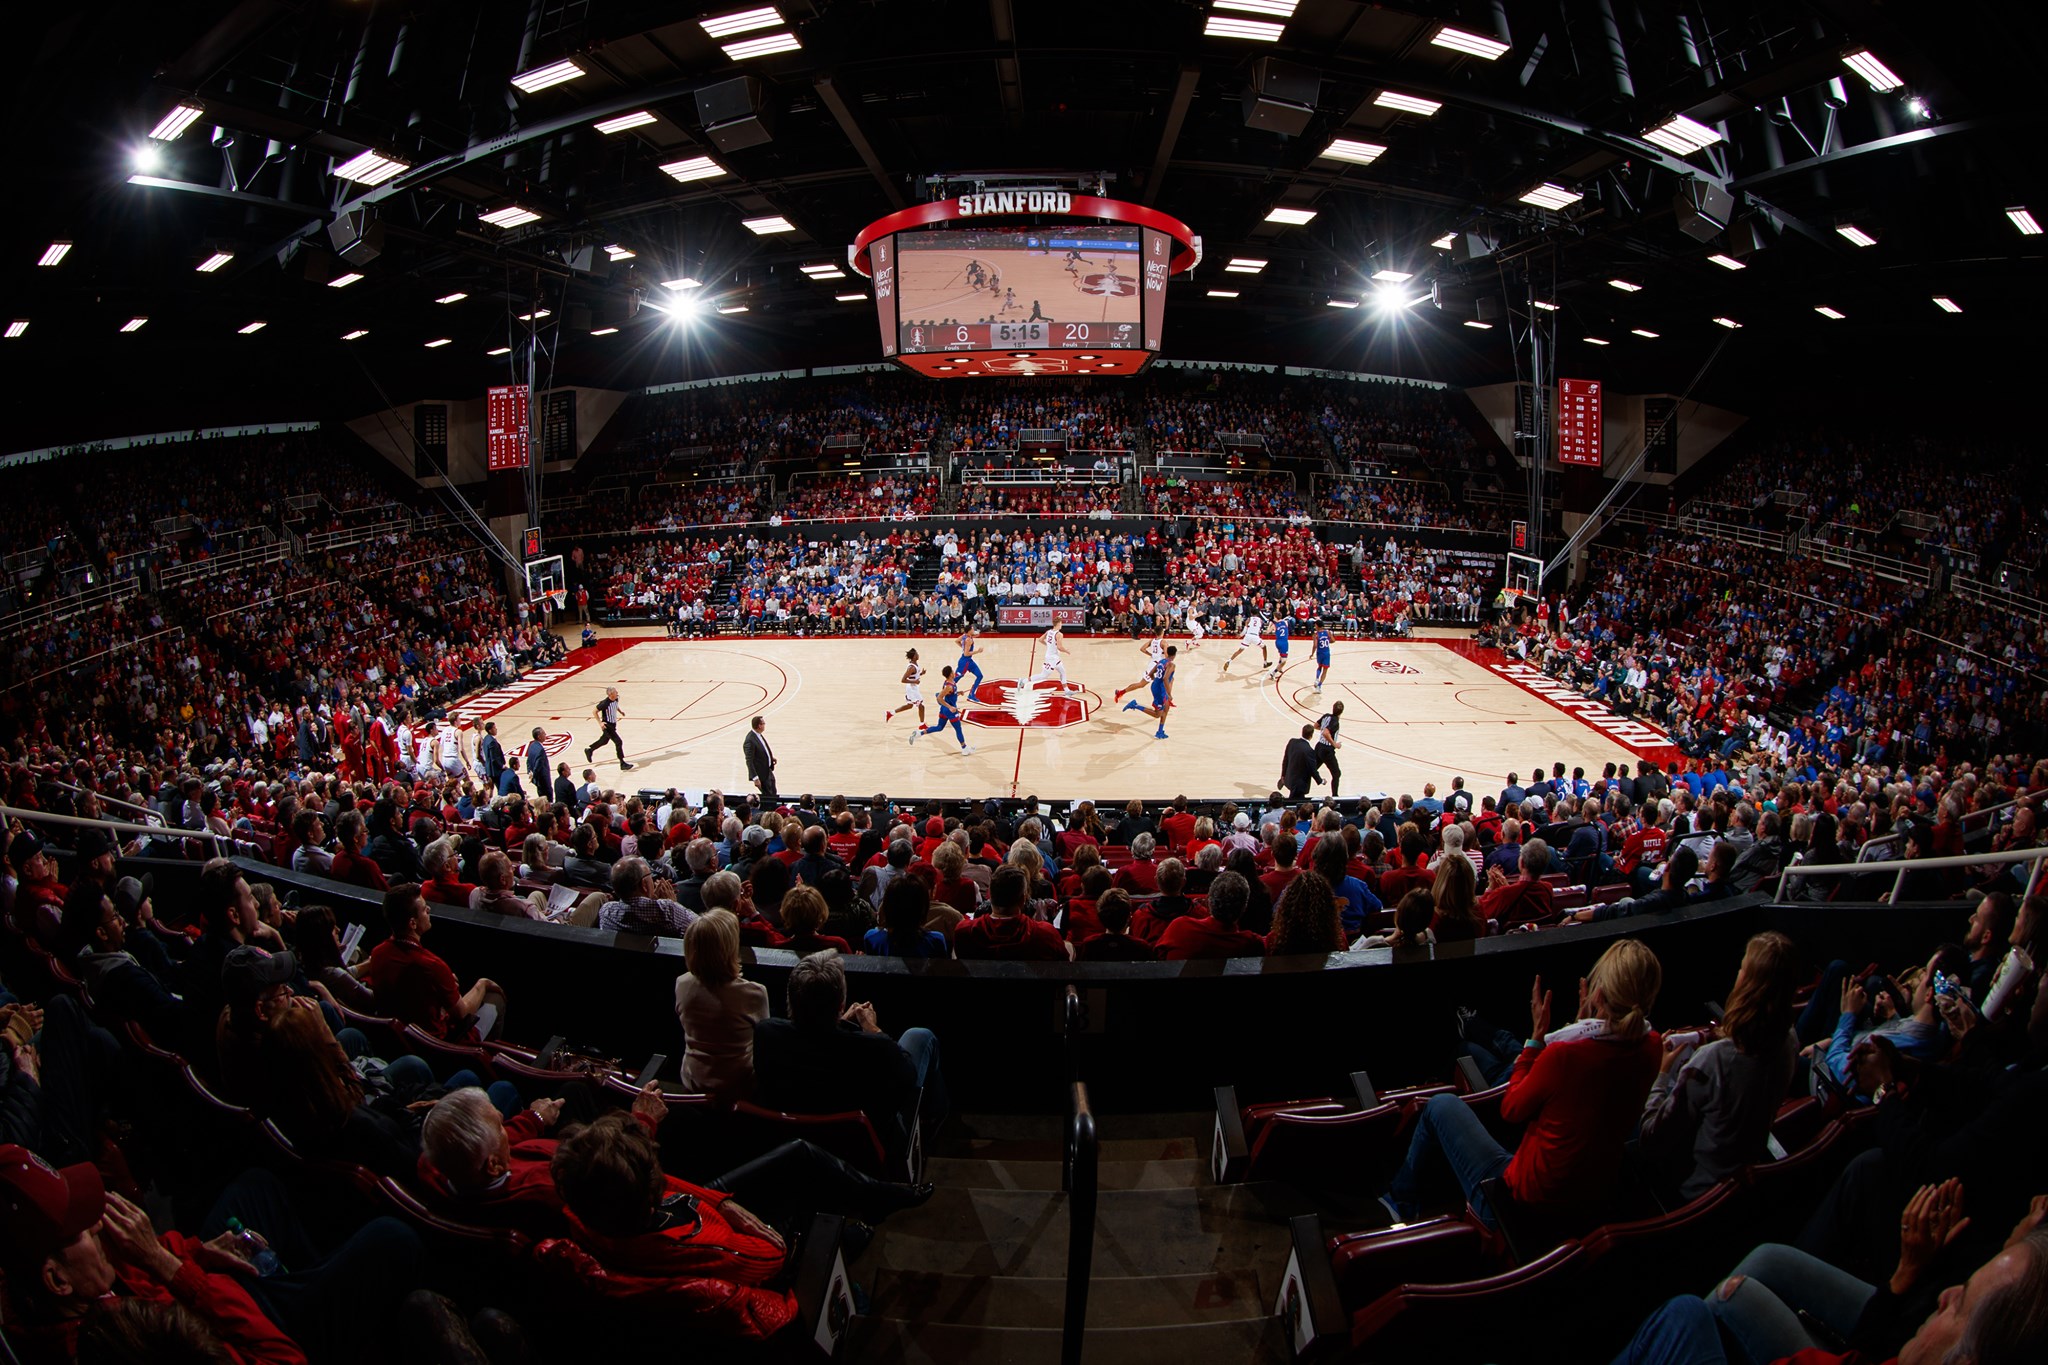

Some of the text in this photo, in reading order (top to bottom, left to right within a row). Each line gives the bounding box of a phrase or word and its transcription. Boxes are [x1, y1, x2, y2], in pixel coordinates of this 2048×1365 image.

[959, 192, 1071, 216] STANFORD
[1147, 278, 1162, 291] NOW
[878, 285, 891, 299] NOW
[957, 326, 968, 342] 6
[1000, 325, 1040, 340] 5:15
[1066, 324, 1089, 340] 20
[1320, 640, 1329, 649] 30
[1490, 664, 1674, 747] STANFORD
[1582, 789, 1588, 799] 4
[1643, 838, 1661, 847] KITTLE
[1580, 1024, 1600, 1034] ATHLET
